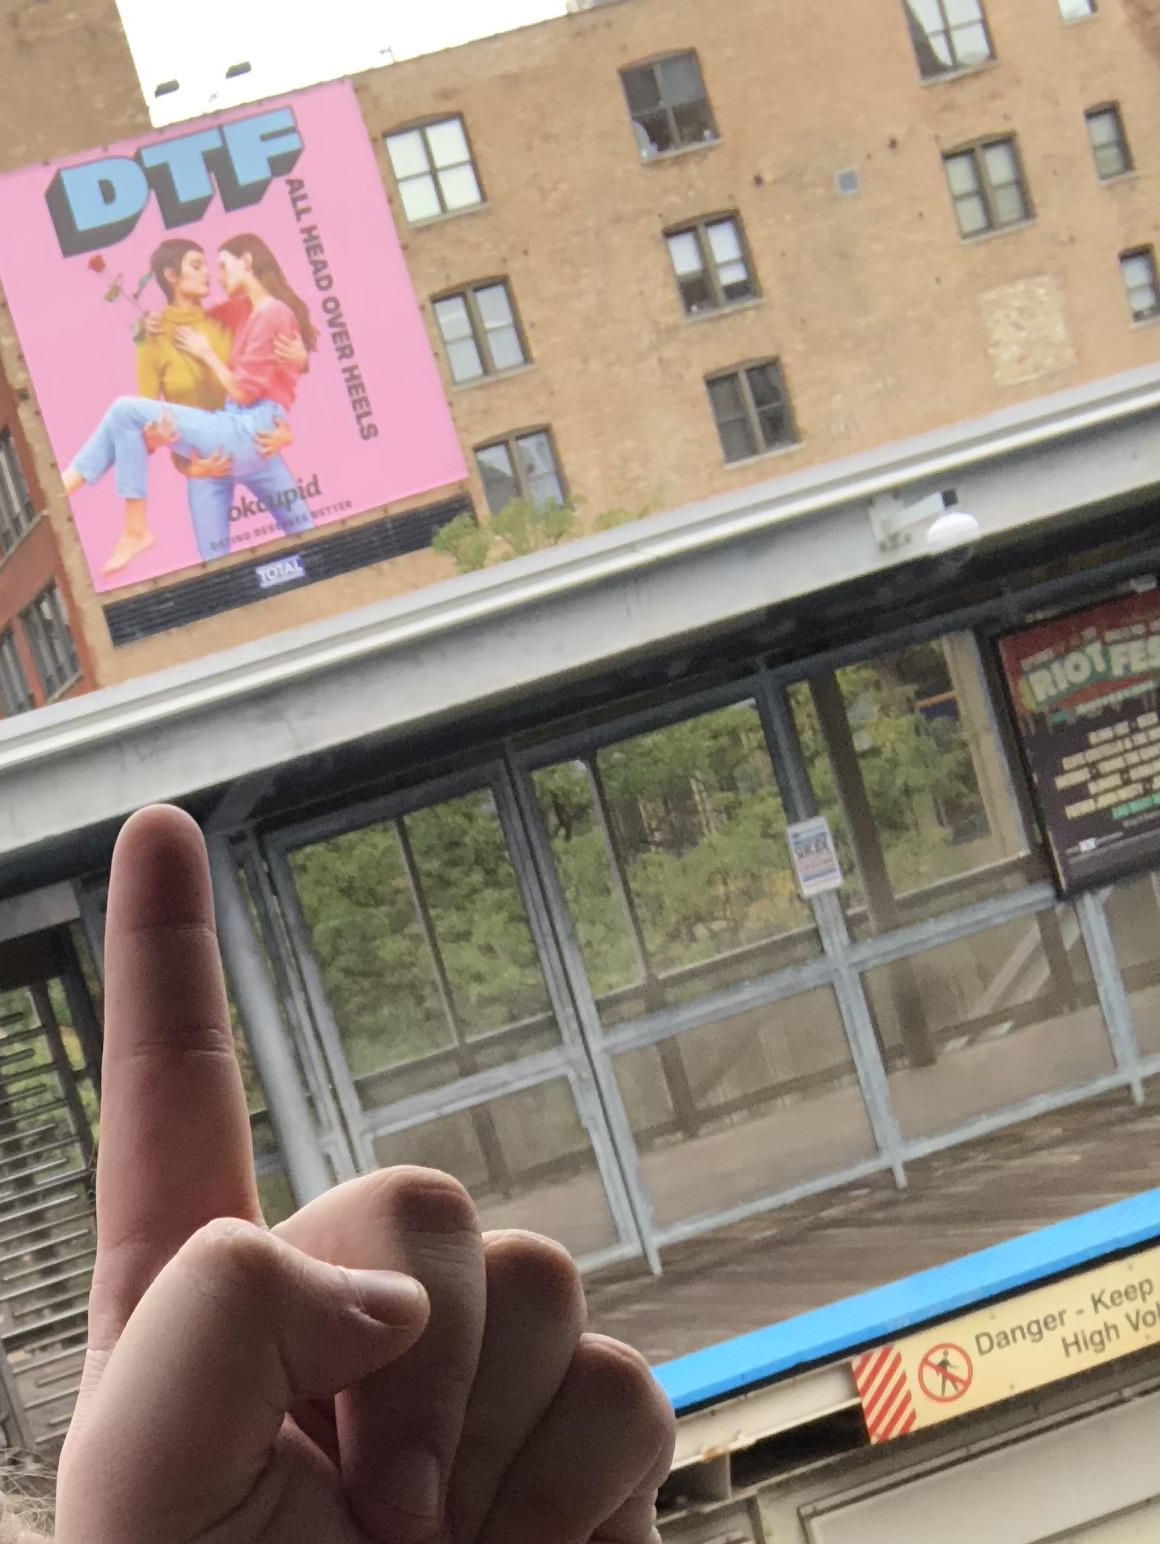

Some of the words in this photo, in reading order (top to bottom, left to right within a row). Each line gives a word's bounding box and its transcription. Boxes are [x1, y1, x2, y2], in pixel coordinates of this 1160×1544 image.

[46, 105, 305, 258] DTF
[285, 178, 313, 222] ALL
[300, 224, 334, 292] HEAD
[321, 296, 355, 362] OVER
[341, 364, 380, 442] HEELS
[227, 473, 322, 522] okcupid
[256, 558, 303, 583] TOTAL
[1027, 639, 1107, 702] RIOT
[974, 1308, 1067, 1357] Danger
[1091, 1278, 1154, 1314] Keep
[1061, 1321, 1121, 1358] High
